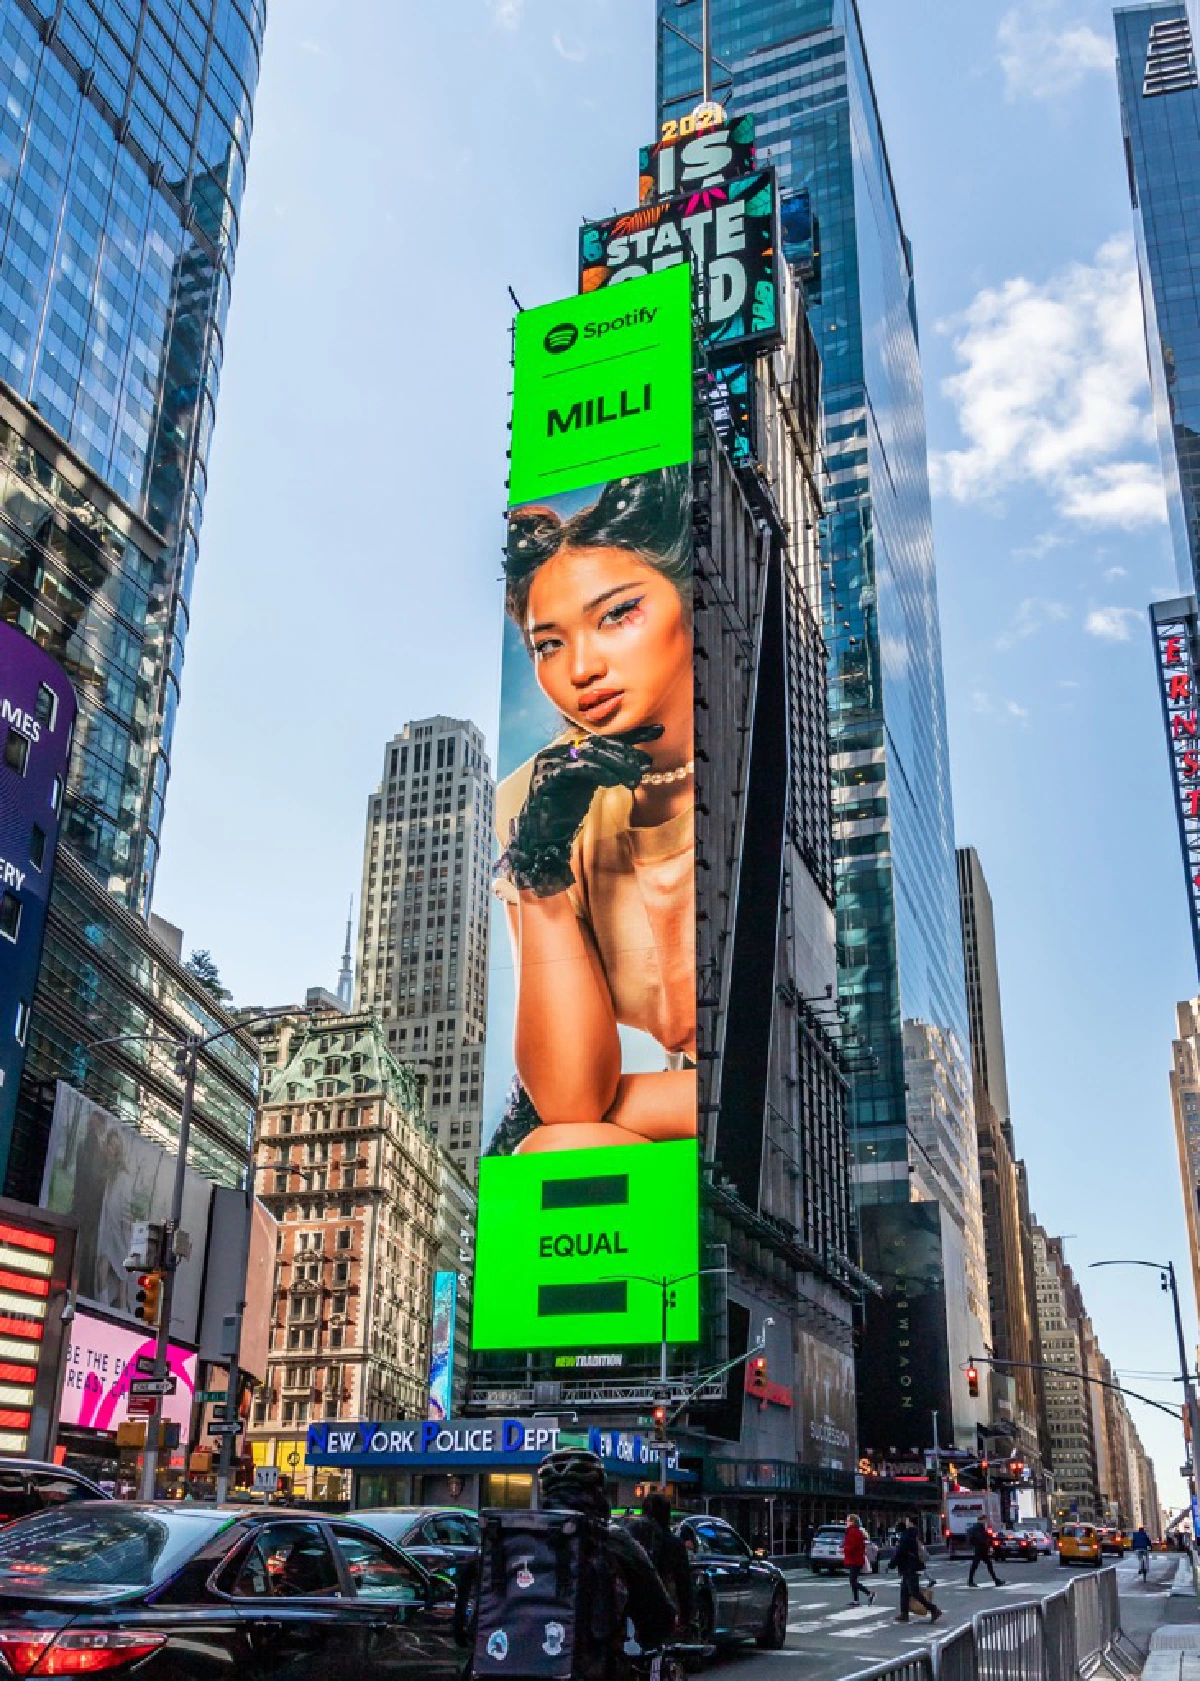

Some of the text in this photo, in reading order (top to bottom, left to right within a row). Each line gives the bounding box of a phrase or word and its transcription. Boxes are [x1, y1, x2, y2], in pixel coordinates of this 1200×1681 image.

[661, 108, 724, 141] 2021
[658, 130, 733, 194] IS
[606, 199, 746, 268] STATE
[583, 306, 658, 339] Spotify
[546, 383, 651, 437] MILLI
[0, 699, 41, 743] MES
[539, 1230, 629, 1258] EQUAL
[87, 1349, 108, 1372] THE
[308, 1419, 560, 1454] NEW YORK POLICE DEPT
